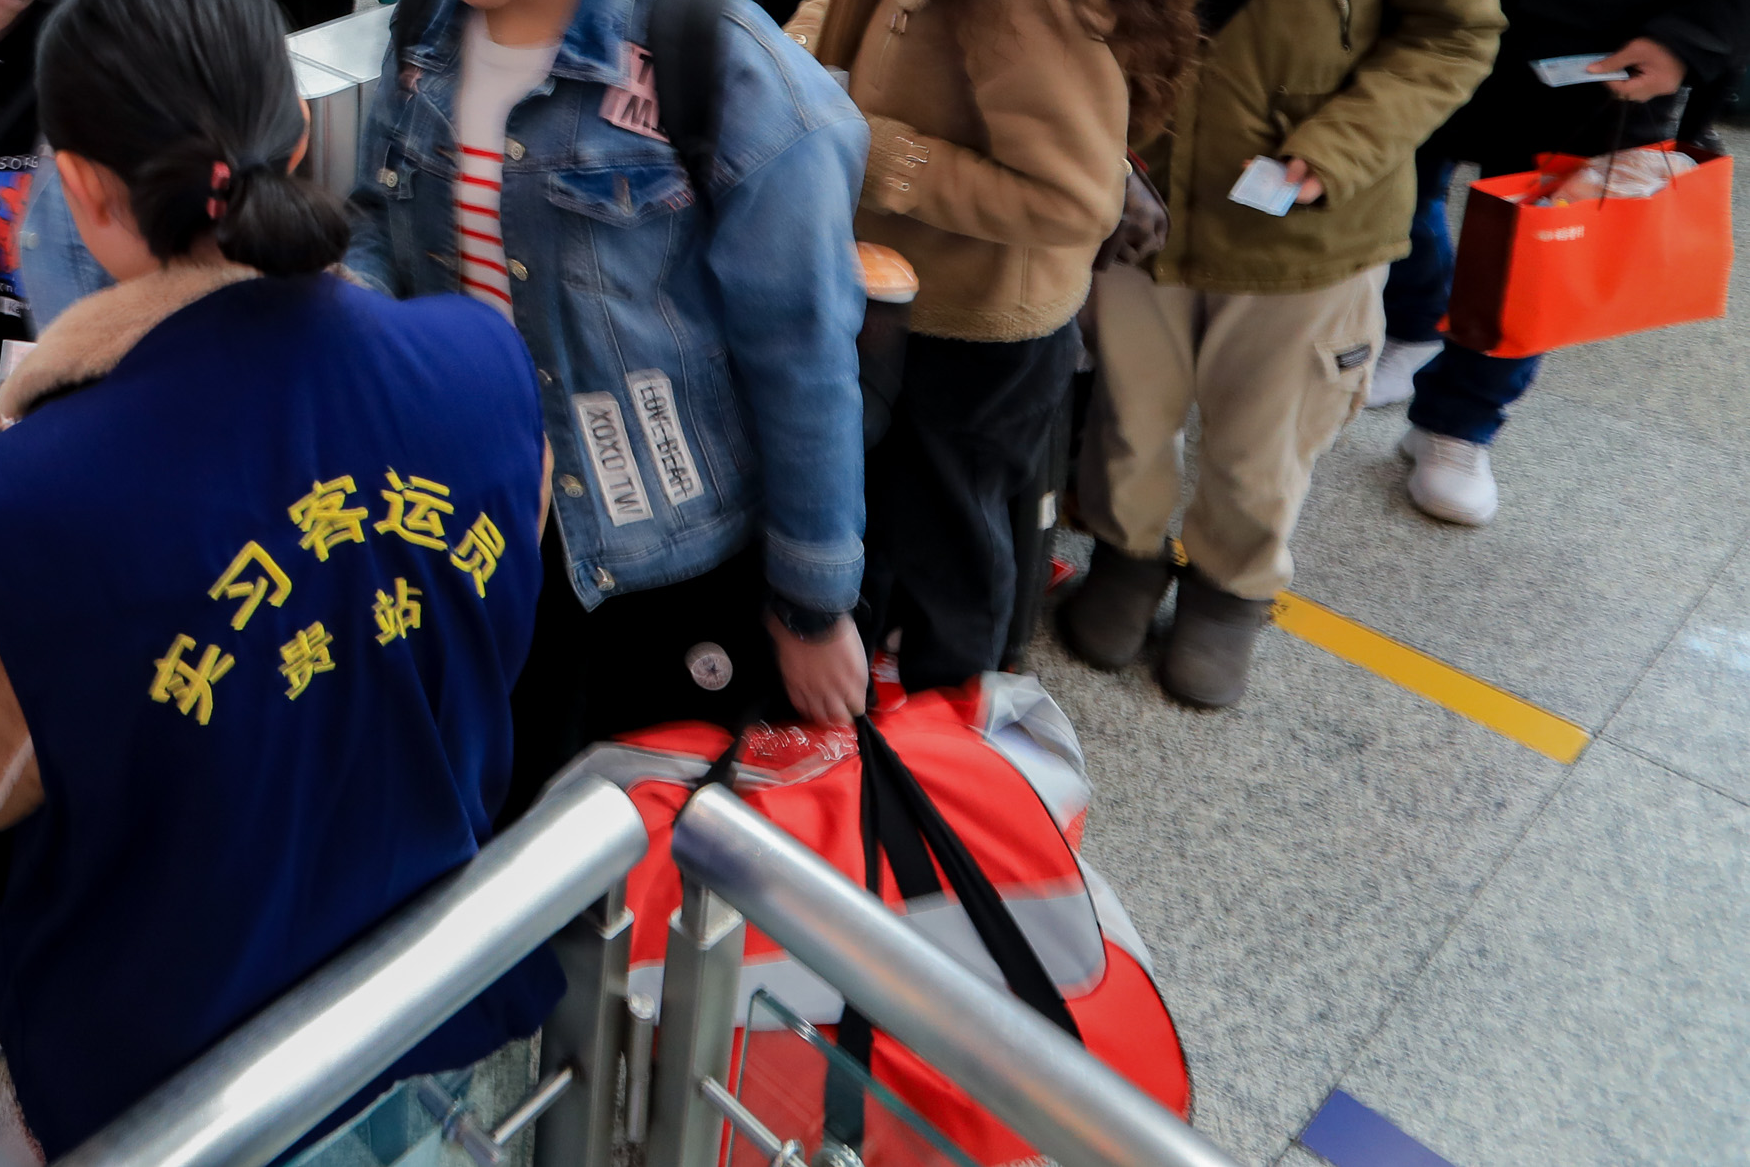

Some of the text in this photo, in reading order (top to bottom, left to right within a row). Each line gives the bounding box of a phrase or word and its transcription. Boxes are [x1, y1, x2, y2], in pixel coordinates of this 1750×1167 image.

[587, 409, 644, 515] XOXO TW
[640, 386, 694, 498] LOVE BEAR
[149, 467, 506, 726] 实习客运员
